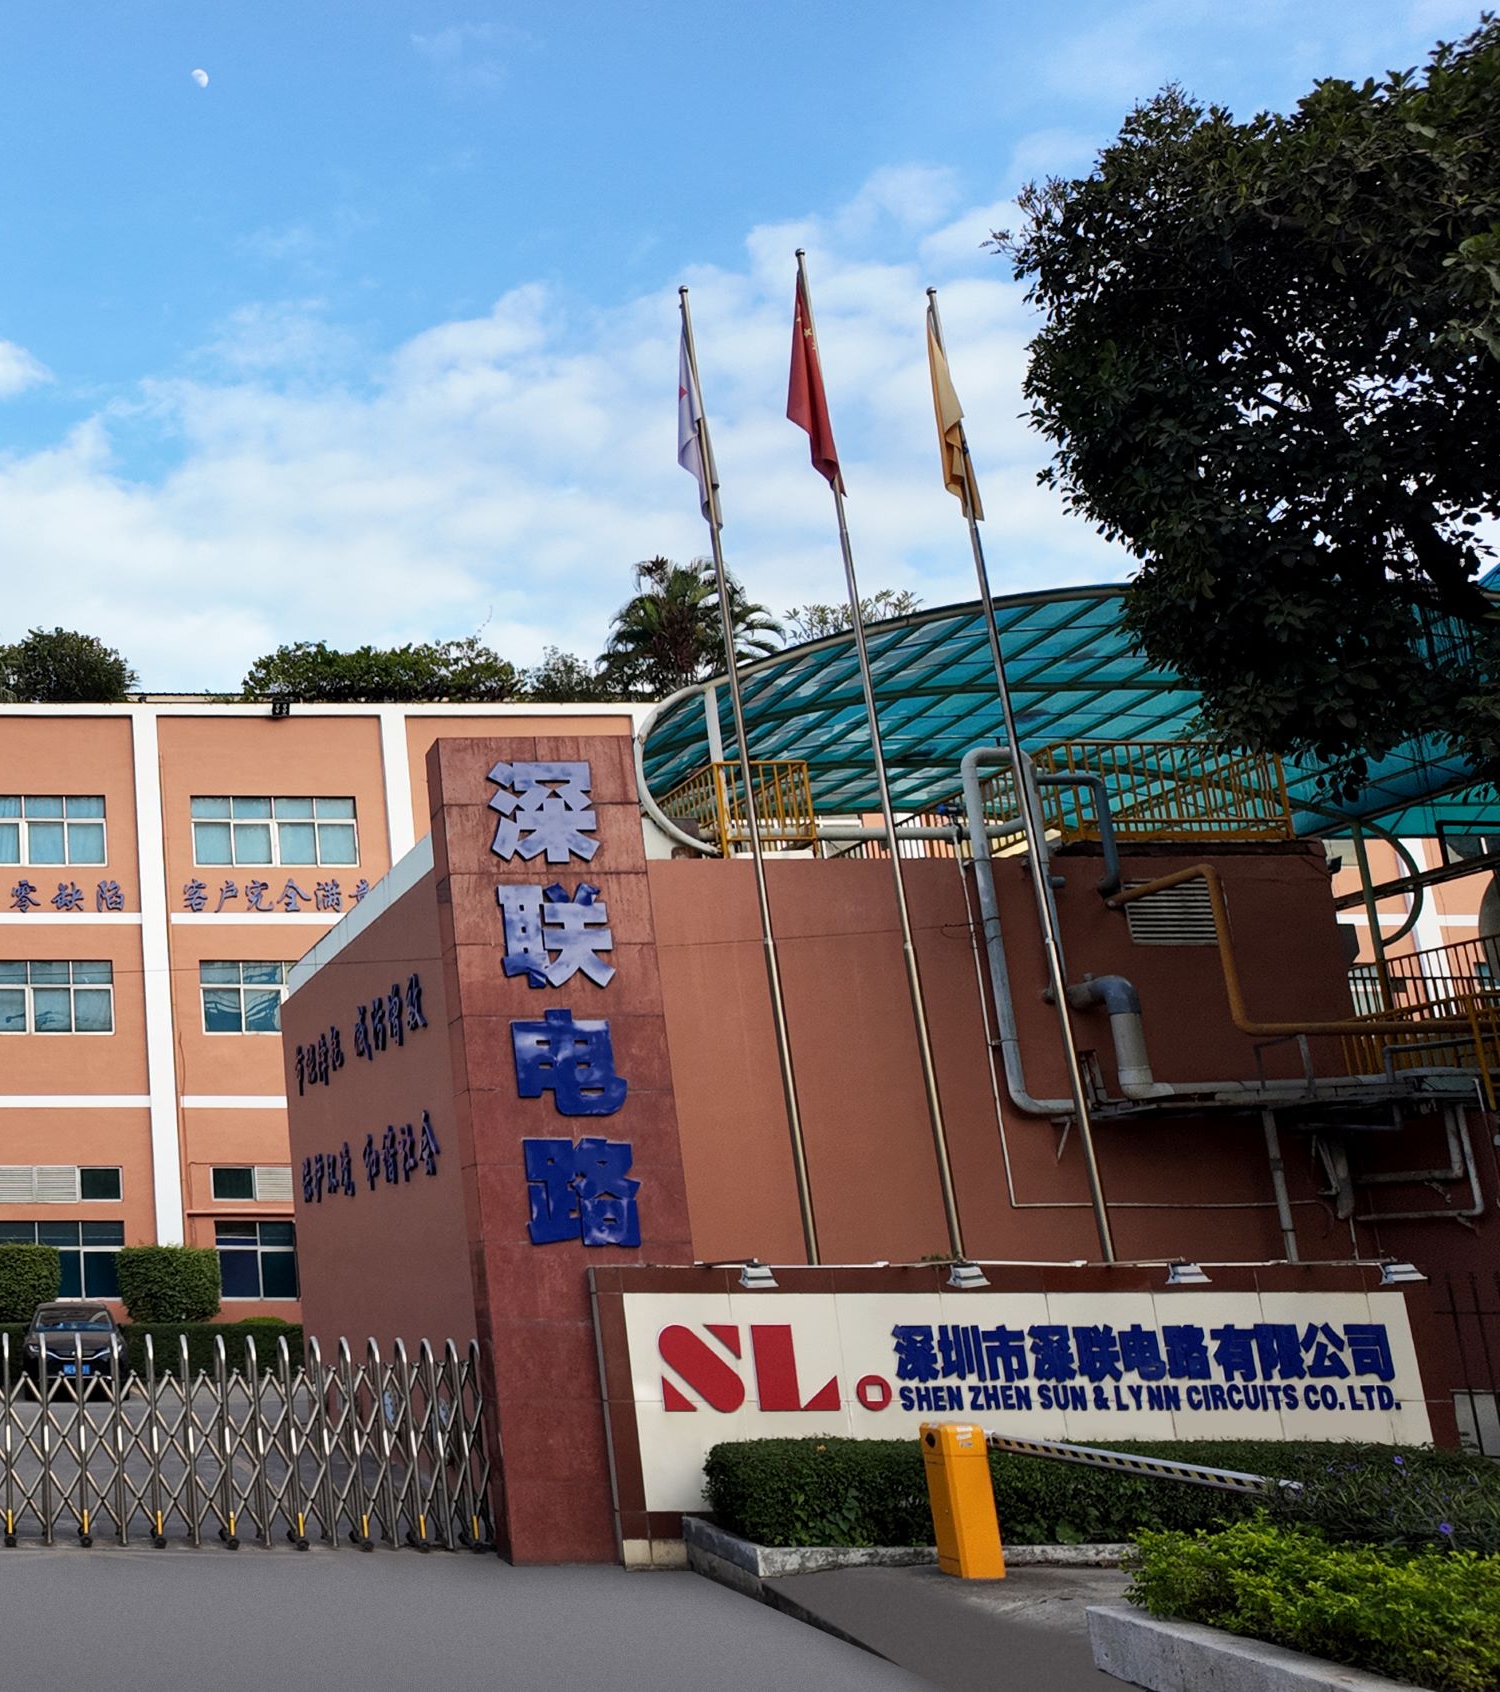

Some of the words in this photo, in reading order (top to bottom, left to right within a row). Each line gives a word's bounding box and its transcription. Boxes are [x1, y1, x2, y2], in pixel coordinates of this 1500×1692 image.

[488, 760, 642, 1248] 深联电路
[892, 1323, 1396, 1383] 深圳市深联电路有限公司
[900, 1386, 965, 1411] SHEN
[970, 1386, 1032, 1410] ZHEN
[1038, 1385, 1088, 1411] SUN
[1094, 1386, 1110, 1410] &
[1115, 1385, 1181, 1411] LYNN
[1186, 1384, 1300, 1411] CIRCUITS
[1304, 1385, 1347, 1411] CO.
[1350, 1385, 1402, 1411] LTD.
